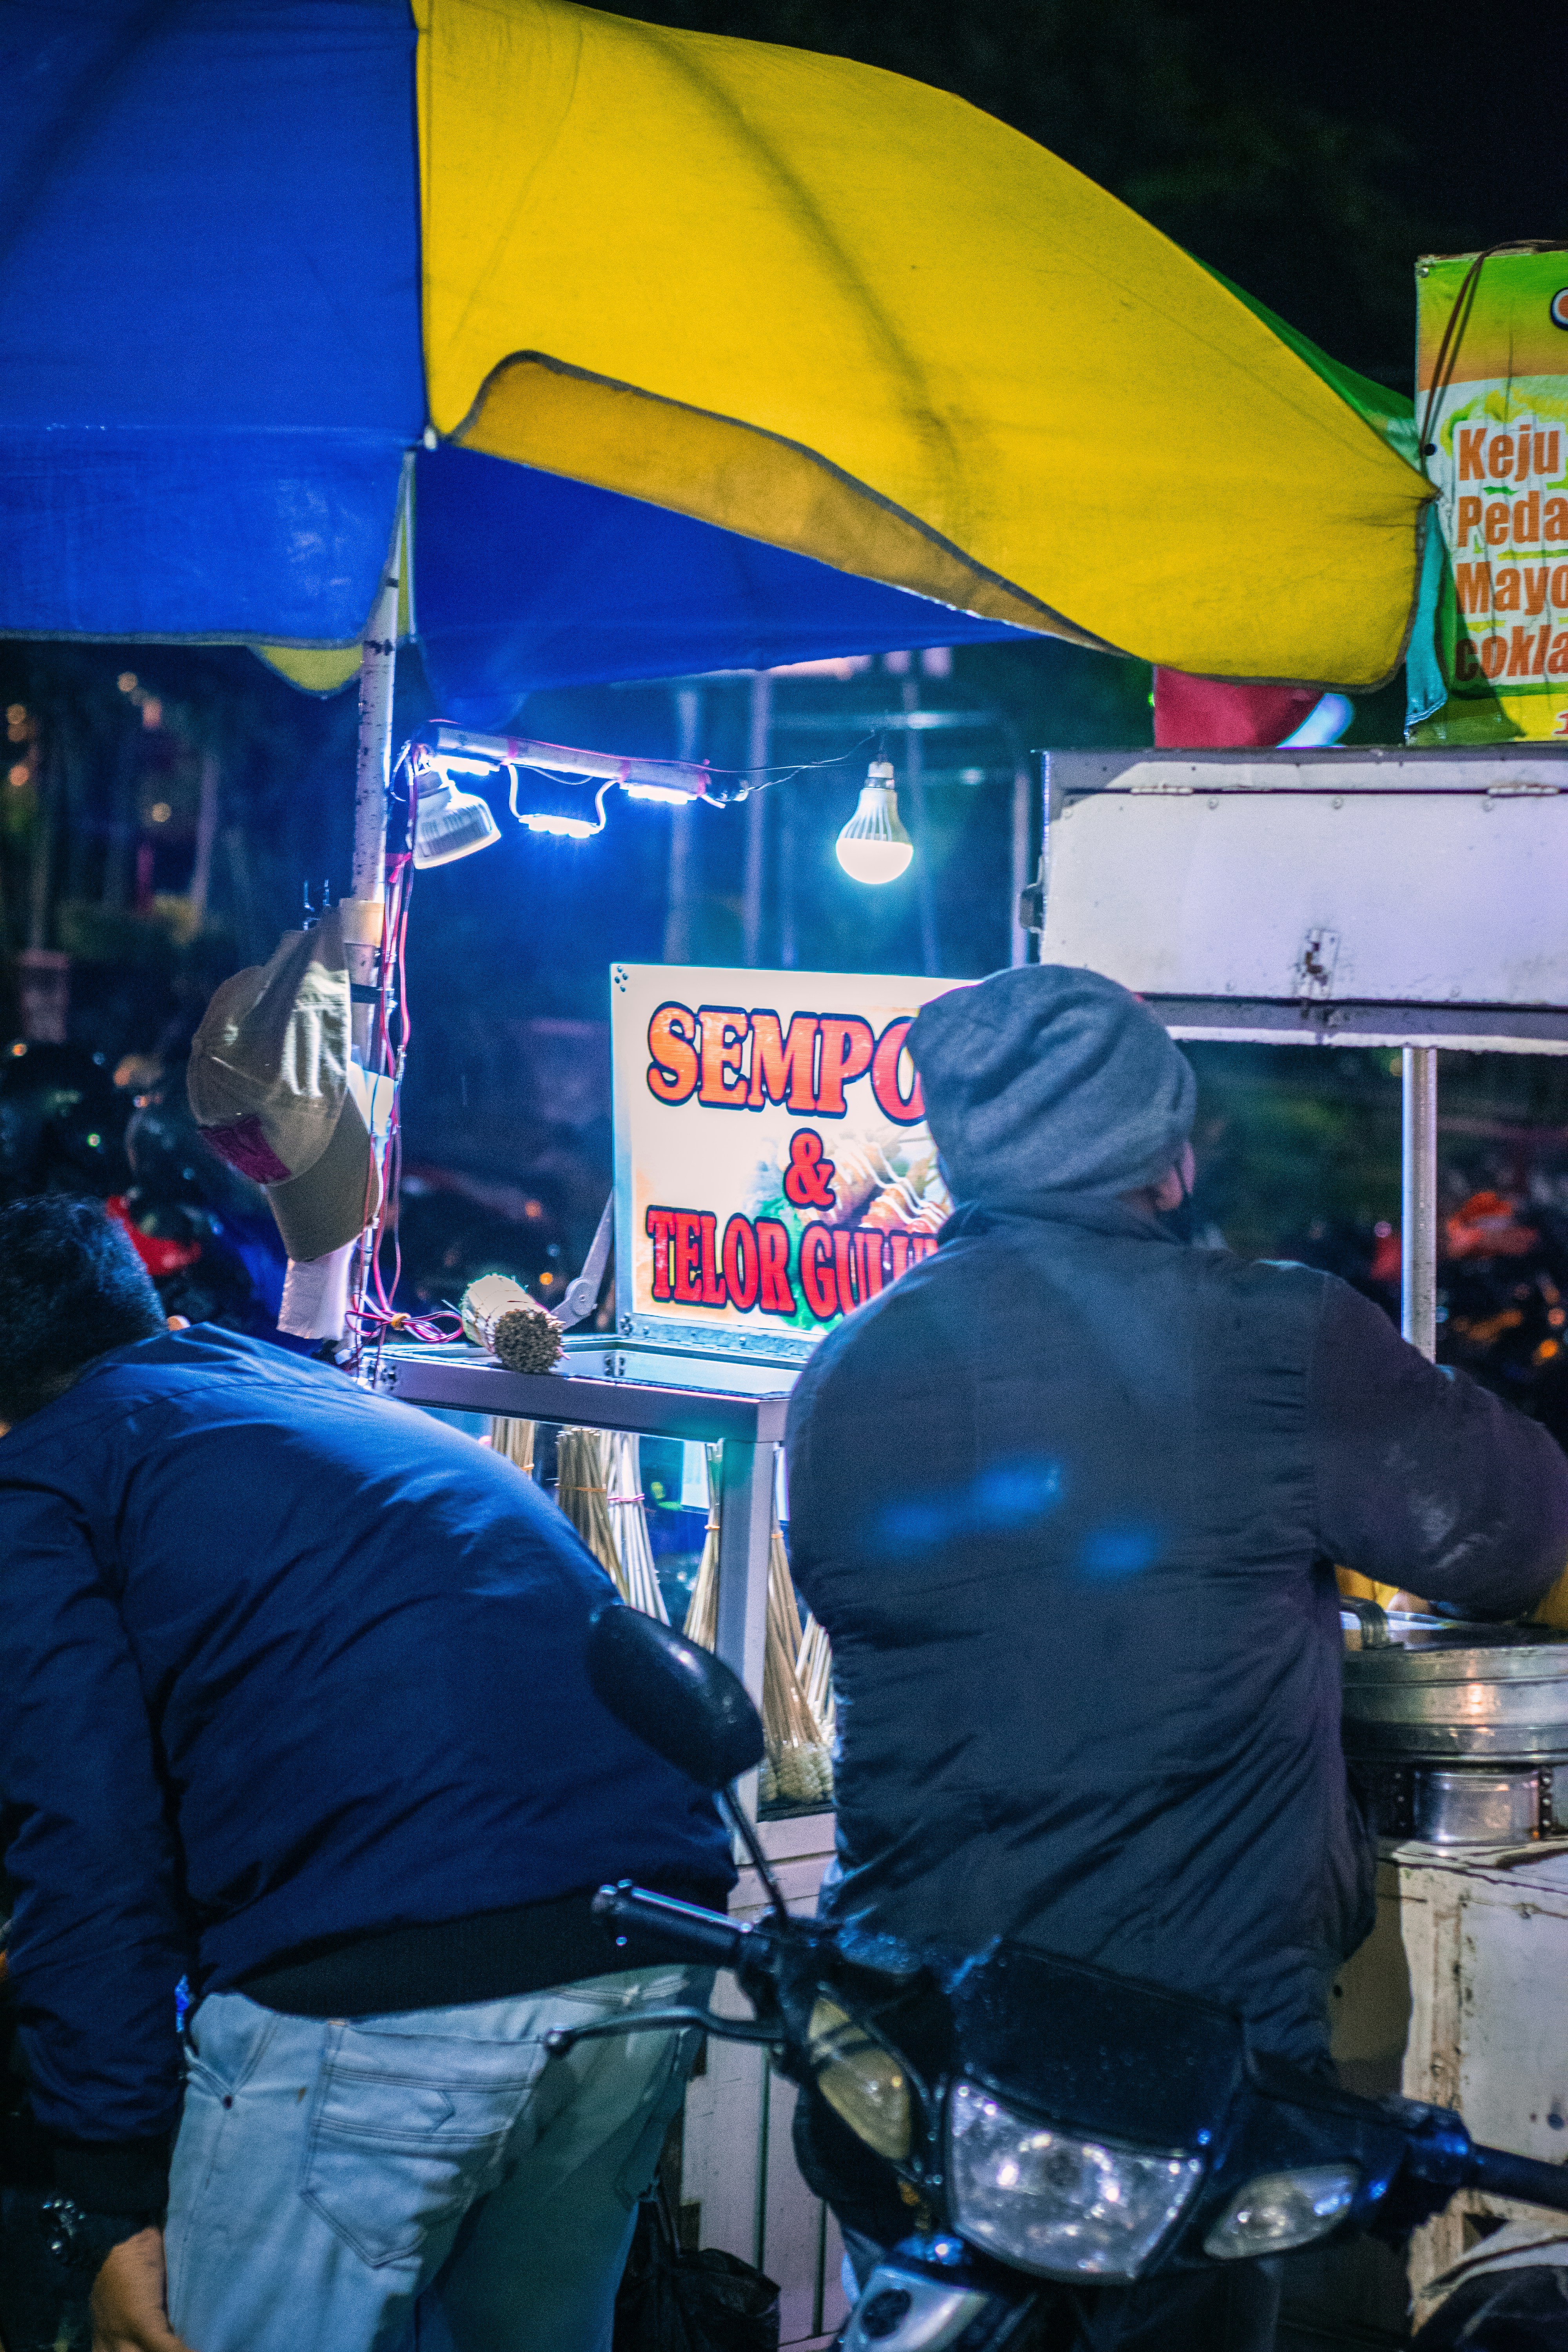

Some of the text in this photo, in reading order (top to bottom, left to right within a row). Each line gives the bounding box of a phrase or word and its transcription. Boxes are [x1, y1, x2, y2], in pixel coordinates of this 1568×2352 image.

[1459, 424, 1560, 482] Keju
[1457, 490, 1568, 548] Peda
[1455, 561, 1568, 615] Mayo
[784, 1128, 837, 1211] &
[646, 1205, 797, 1317] TELOR
